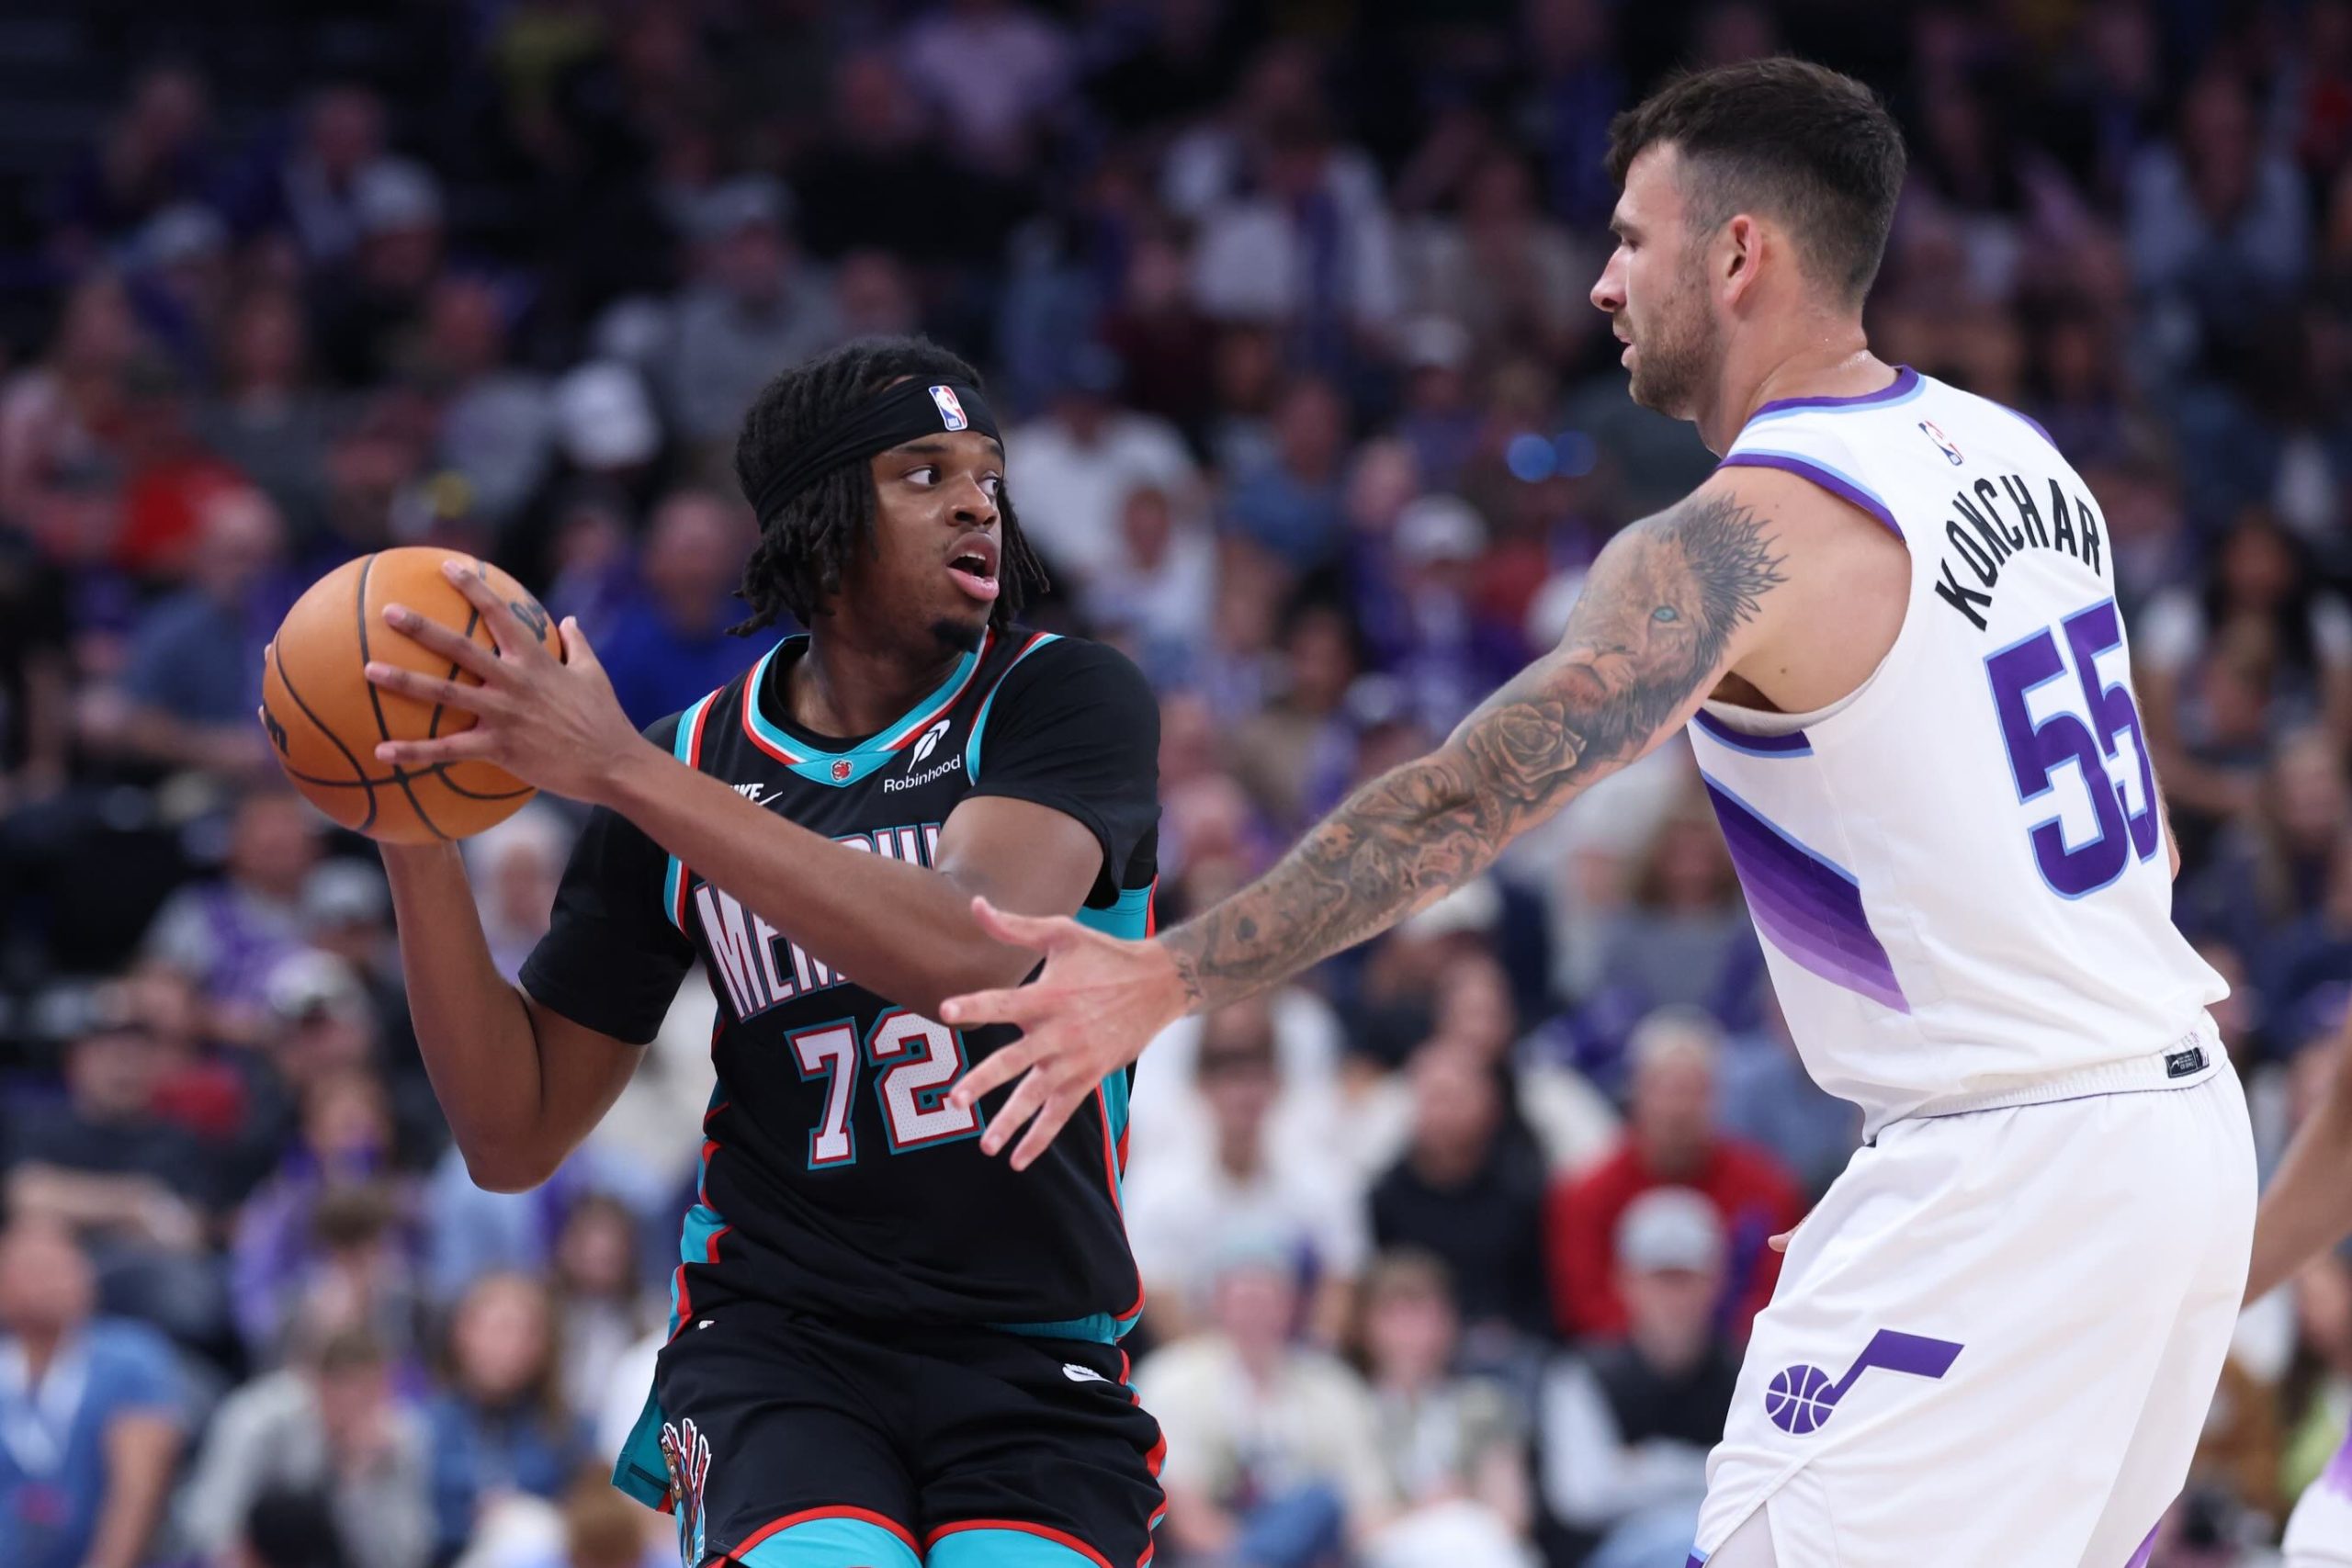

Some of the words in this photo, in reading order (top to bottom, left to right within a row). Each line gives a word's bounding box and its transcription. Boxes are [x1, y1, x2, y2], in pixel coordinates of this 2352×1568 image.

[1935, 474, 2102, 631] KONCHAR
[884, 753, 961, 793] Robinhood
[1983, 597, 2161, 900] 55
[785, 1005, 987, 1170] 72
